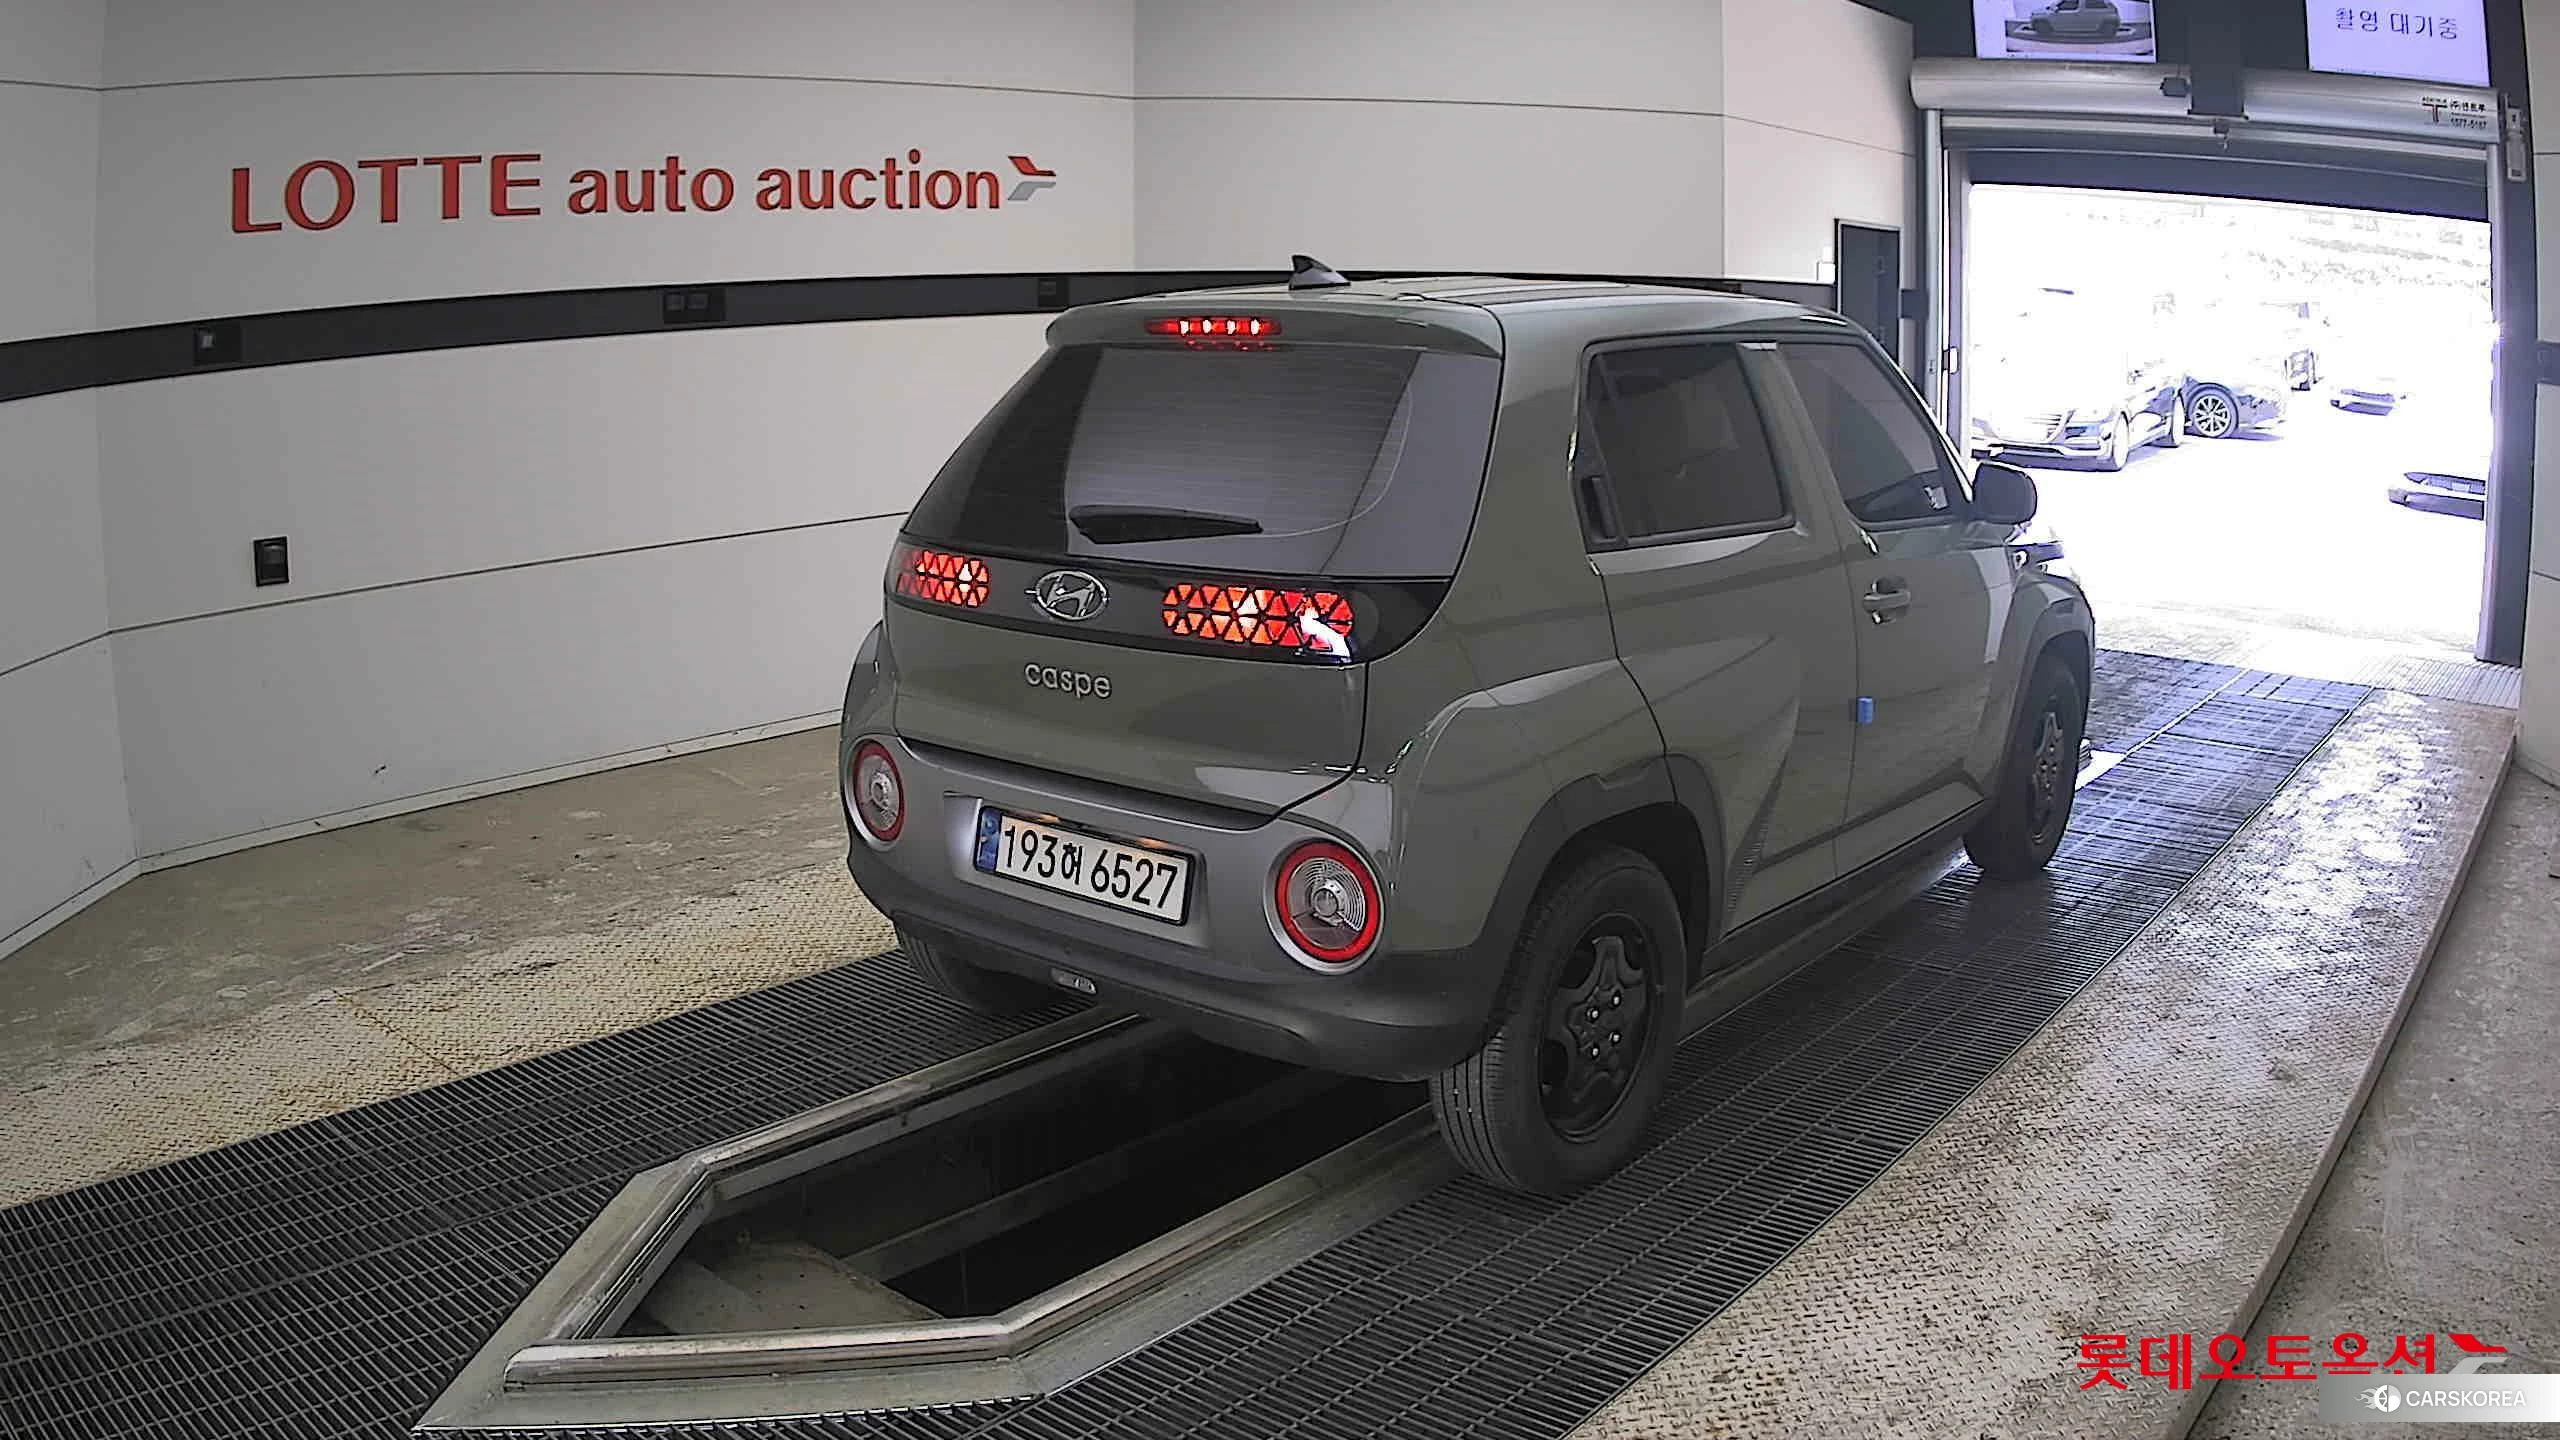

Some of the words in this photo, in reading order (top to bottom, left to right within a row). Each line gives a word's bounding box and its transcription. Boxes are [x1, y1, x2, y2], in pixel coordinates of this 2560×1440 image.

[2336, 8, 2378, 32] 촬영
[2391, 14, 2458, 40] 대기중
[232, 153, 542, 233] LOTTE
[568, 155, 735, 214] auto
[756, 148, 1000, 211] auction
[1025, 664, 1111, 699] caspe
[1004, 825, 1084, 886] 193허
[1090, 849, 1179, 909] 6527
